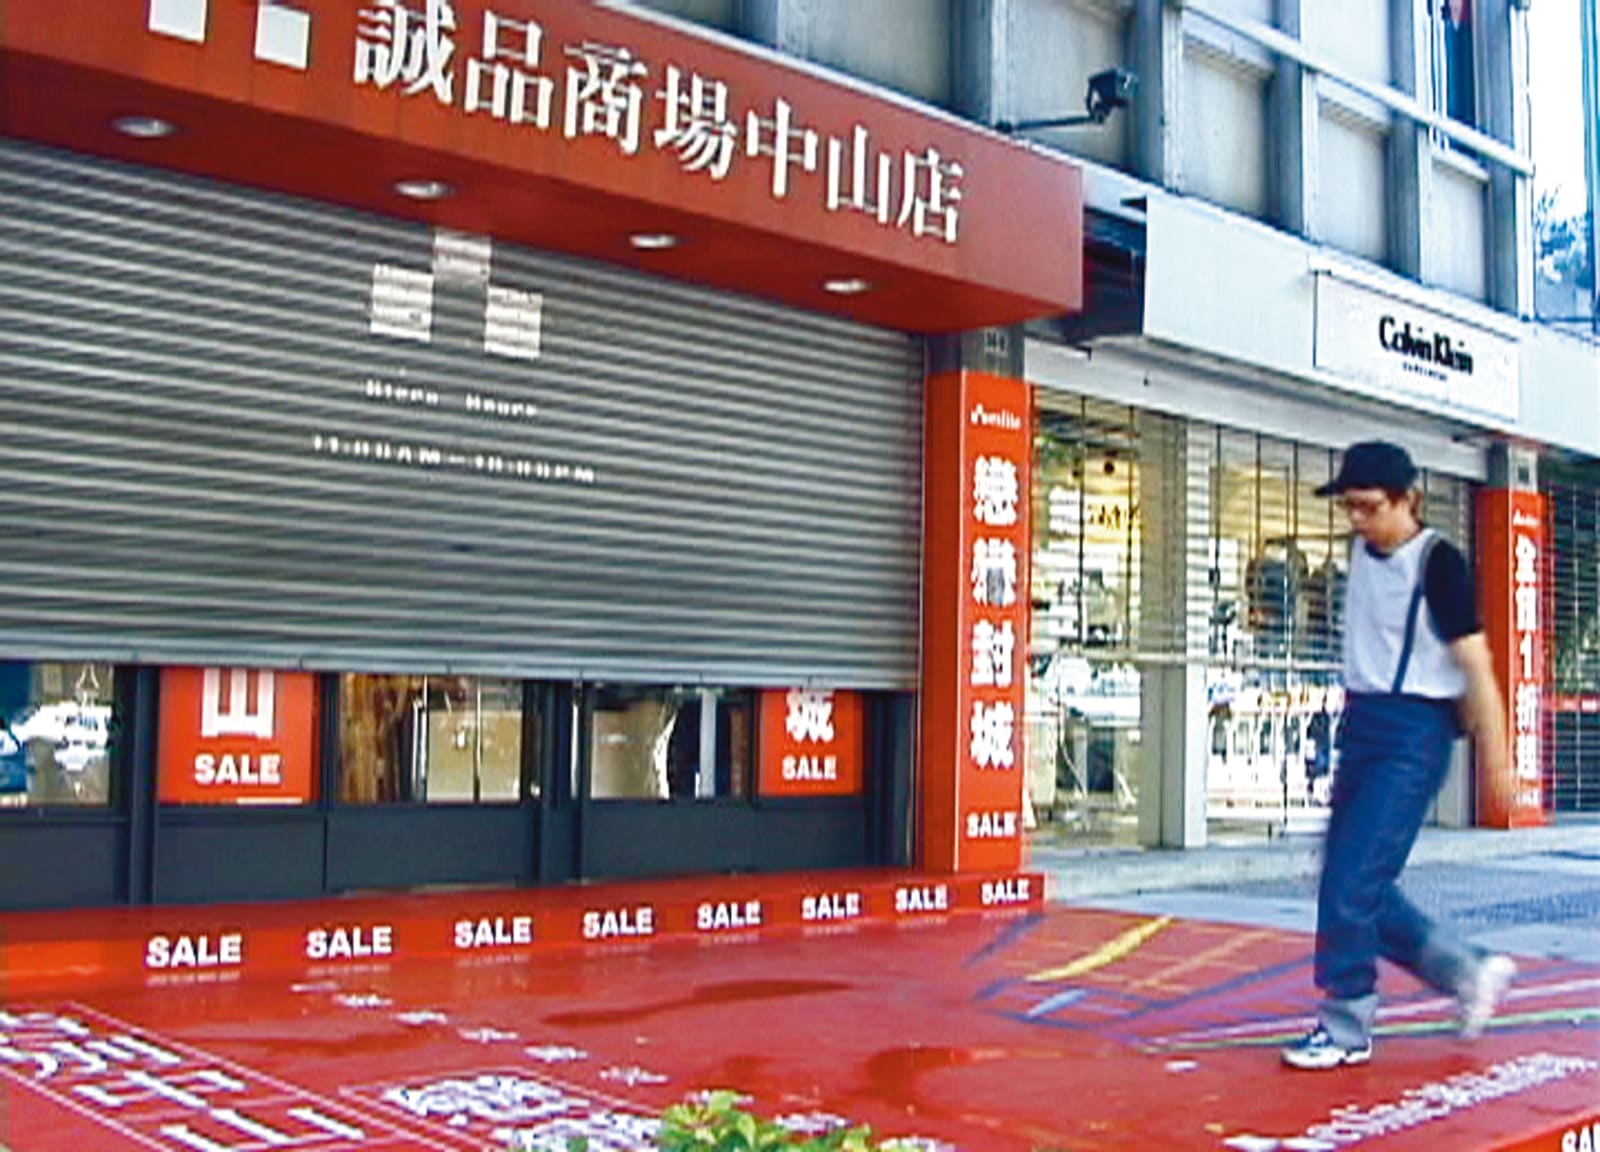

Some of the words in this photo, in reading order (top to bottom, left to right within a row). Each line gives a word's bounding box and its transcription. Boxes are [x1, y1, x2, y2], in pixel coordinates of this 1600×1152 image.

[353, 0, 964, 244] 誠品商場中山店
[1379, 315, 1432, 362] Calvin
[1433, 332, 1473, 376] Klein
[194, 754, 281, 785] SALE
[782, 755, 837, 780] SALE
[966, 812, 1017, 839] SALE
[146, 935, 242, 969] SALE
[307, 927, 392, 958] SALE
[455, 917, 532, 948] SALE
[583, 907, 653, 938] SALE
[698, 901, 761, 929] SALE
[803, 893, 859, 920] SALE
[896, 885, 948, 911] SALE
[981, 879, 1030, 904] SALE
